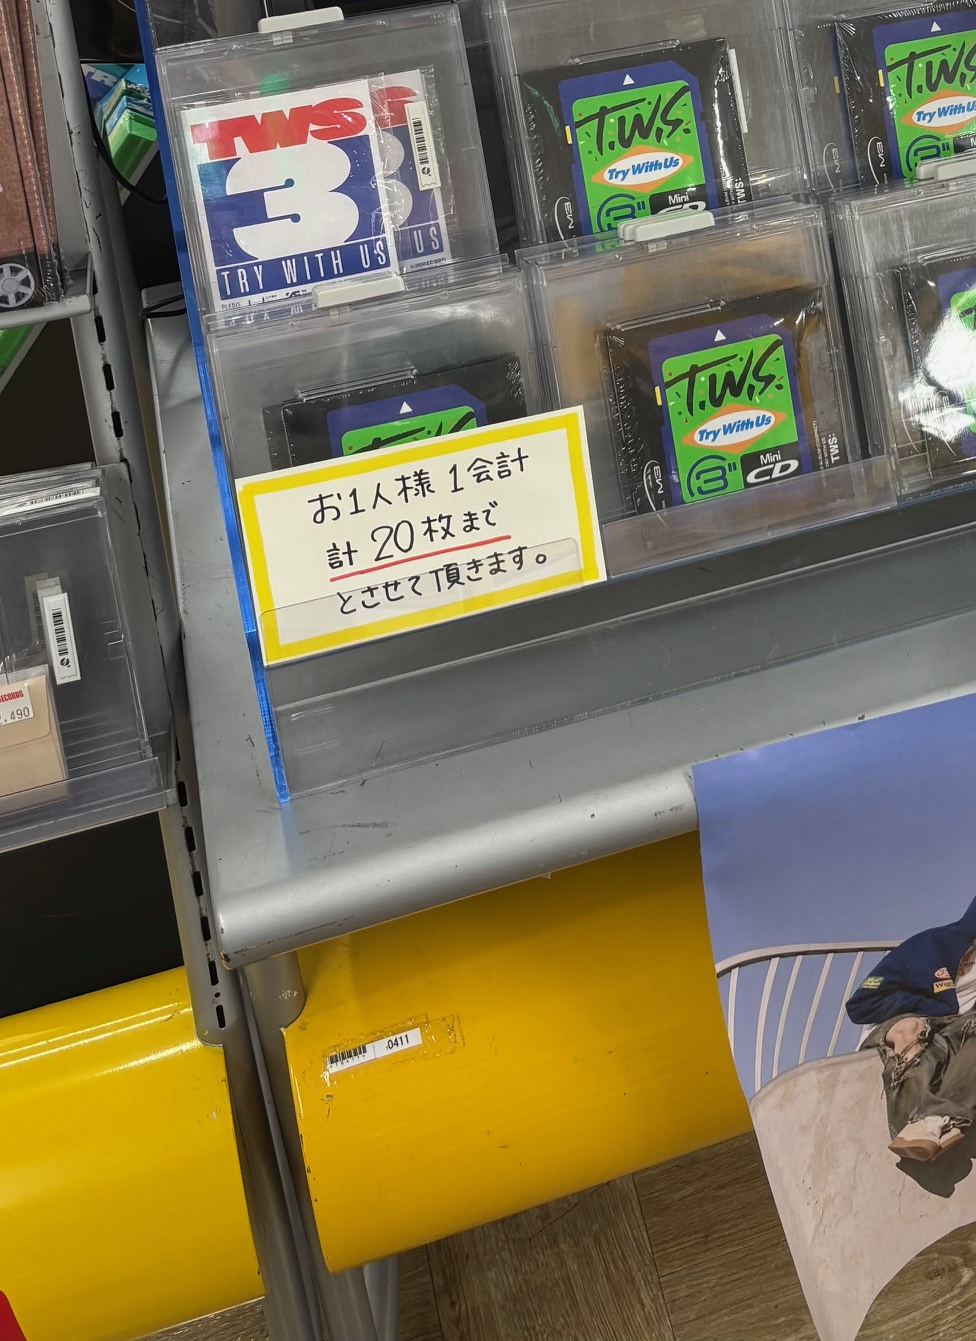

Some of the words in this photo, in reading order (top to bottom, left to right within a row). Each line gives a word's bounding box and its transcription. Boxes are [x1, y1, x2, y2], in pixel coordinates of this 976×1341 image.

[915, 108, 938, 126] Try
[936, 103, 964, 121] With
[190, 97, 367, 162] TWS
[607, 168, 630, 181] Try
[631, 161, 662, 175] With
[662, 156, 680, 168] Us
[223, 136, 360, 259] 3
[668, 192, 689, 206] Mini
[413, 228, 440, 253] US
[221, 265, 264, 297] TRY
[282, 250, 344, 285] WITH
[359, 240, 388, 269] US
[697, 424, 723, 445] Try
[721, 417, 755, 438] With
[754, 413, 773, 429] Us
[760, 451, 781, 465] Mini
[828, 433, 840, 464] TWS:
[746, 459, 799, 484] CD
[338, 546, 549, 615] とさせて頂きます。
